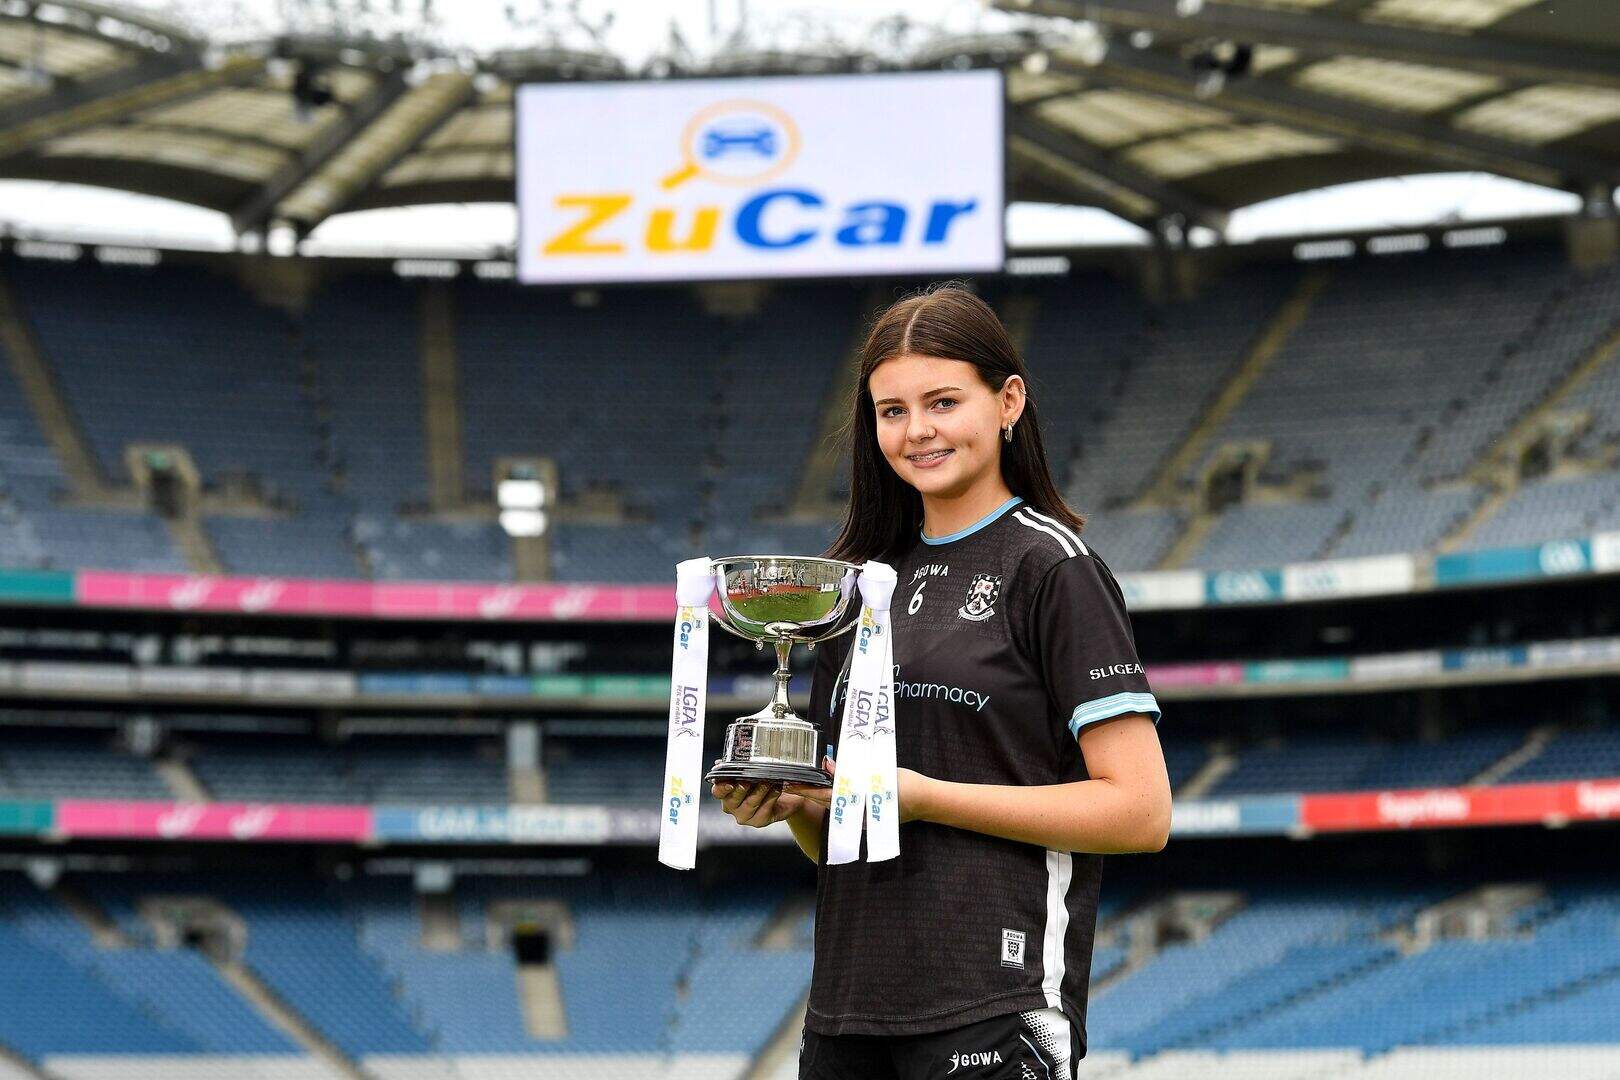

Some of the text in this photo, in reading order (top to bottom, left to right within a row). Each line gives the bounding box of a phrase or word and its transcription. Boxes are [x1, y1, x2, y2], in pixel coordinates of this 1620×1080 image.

[541, 188, 978, 256] ZuCar
[908, 581, 926, 615] 6
[1090, 663, 1145, 680] SLIGEA
[960, 1050, 1003, 1067] GOWA
